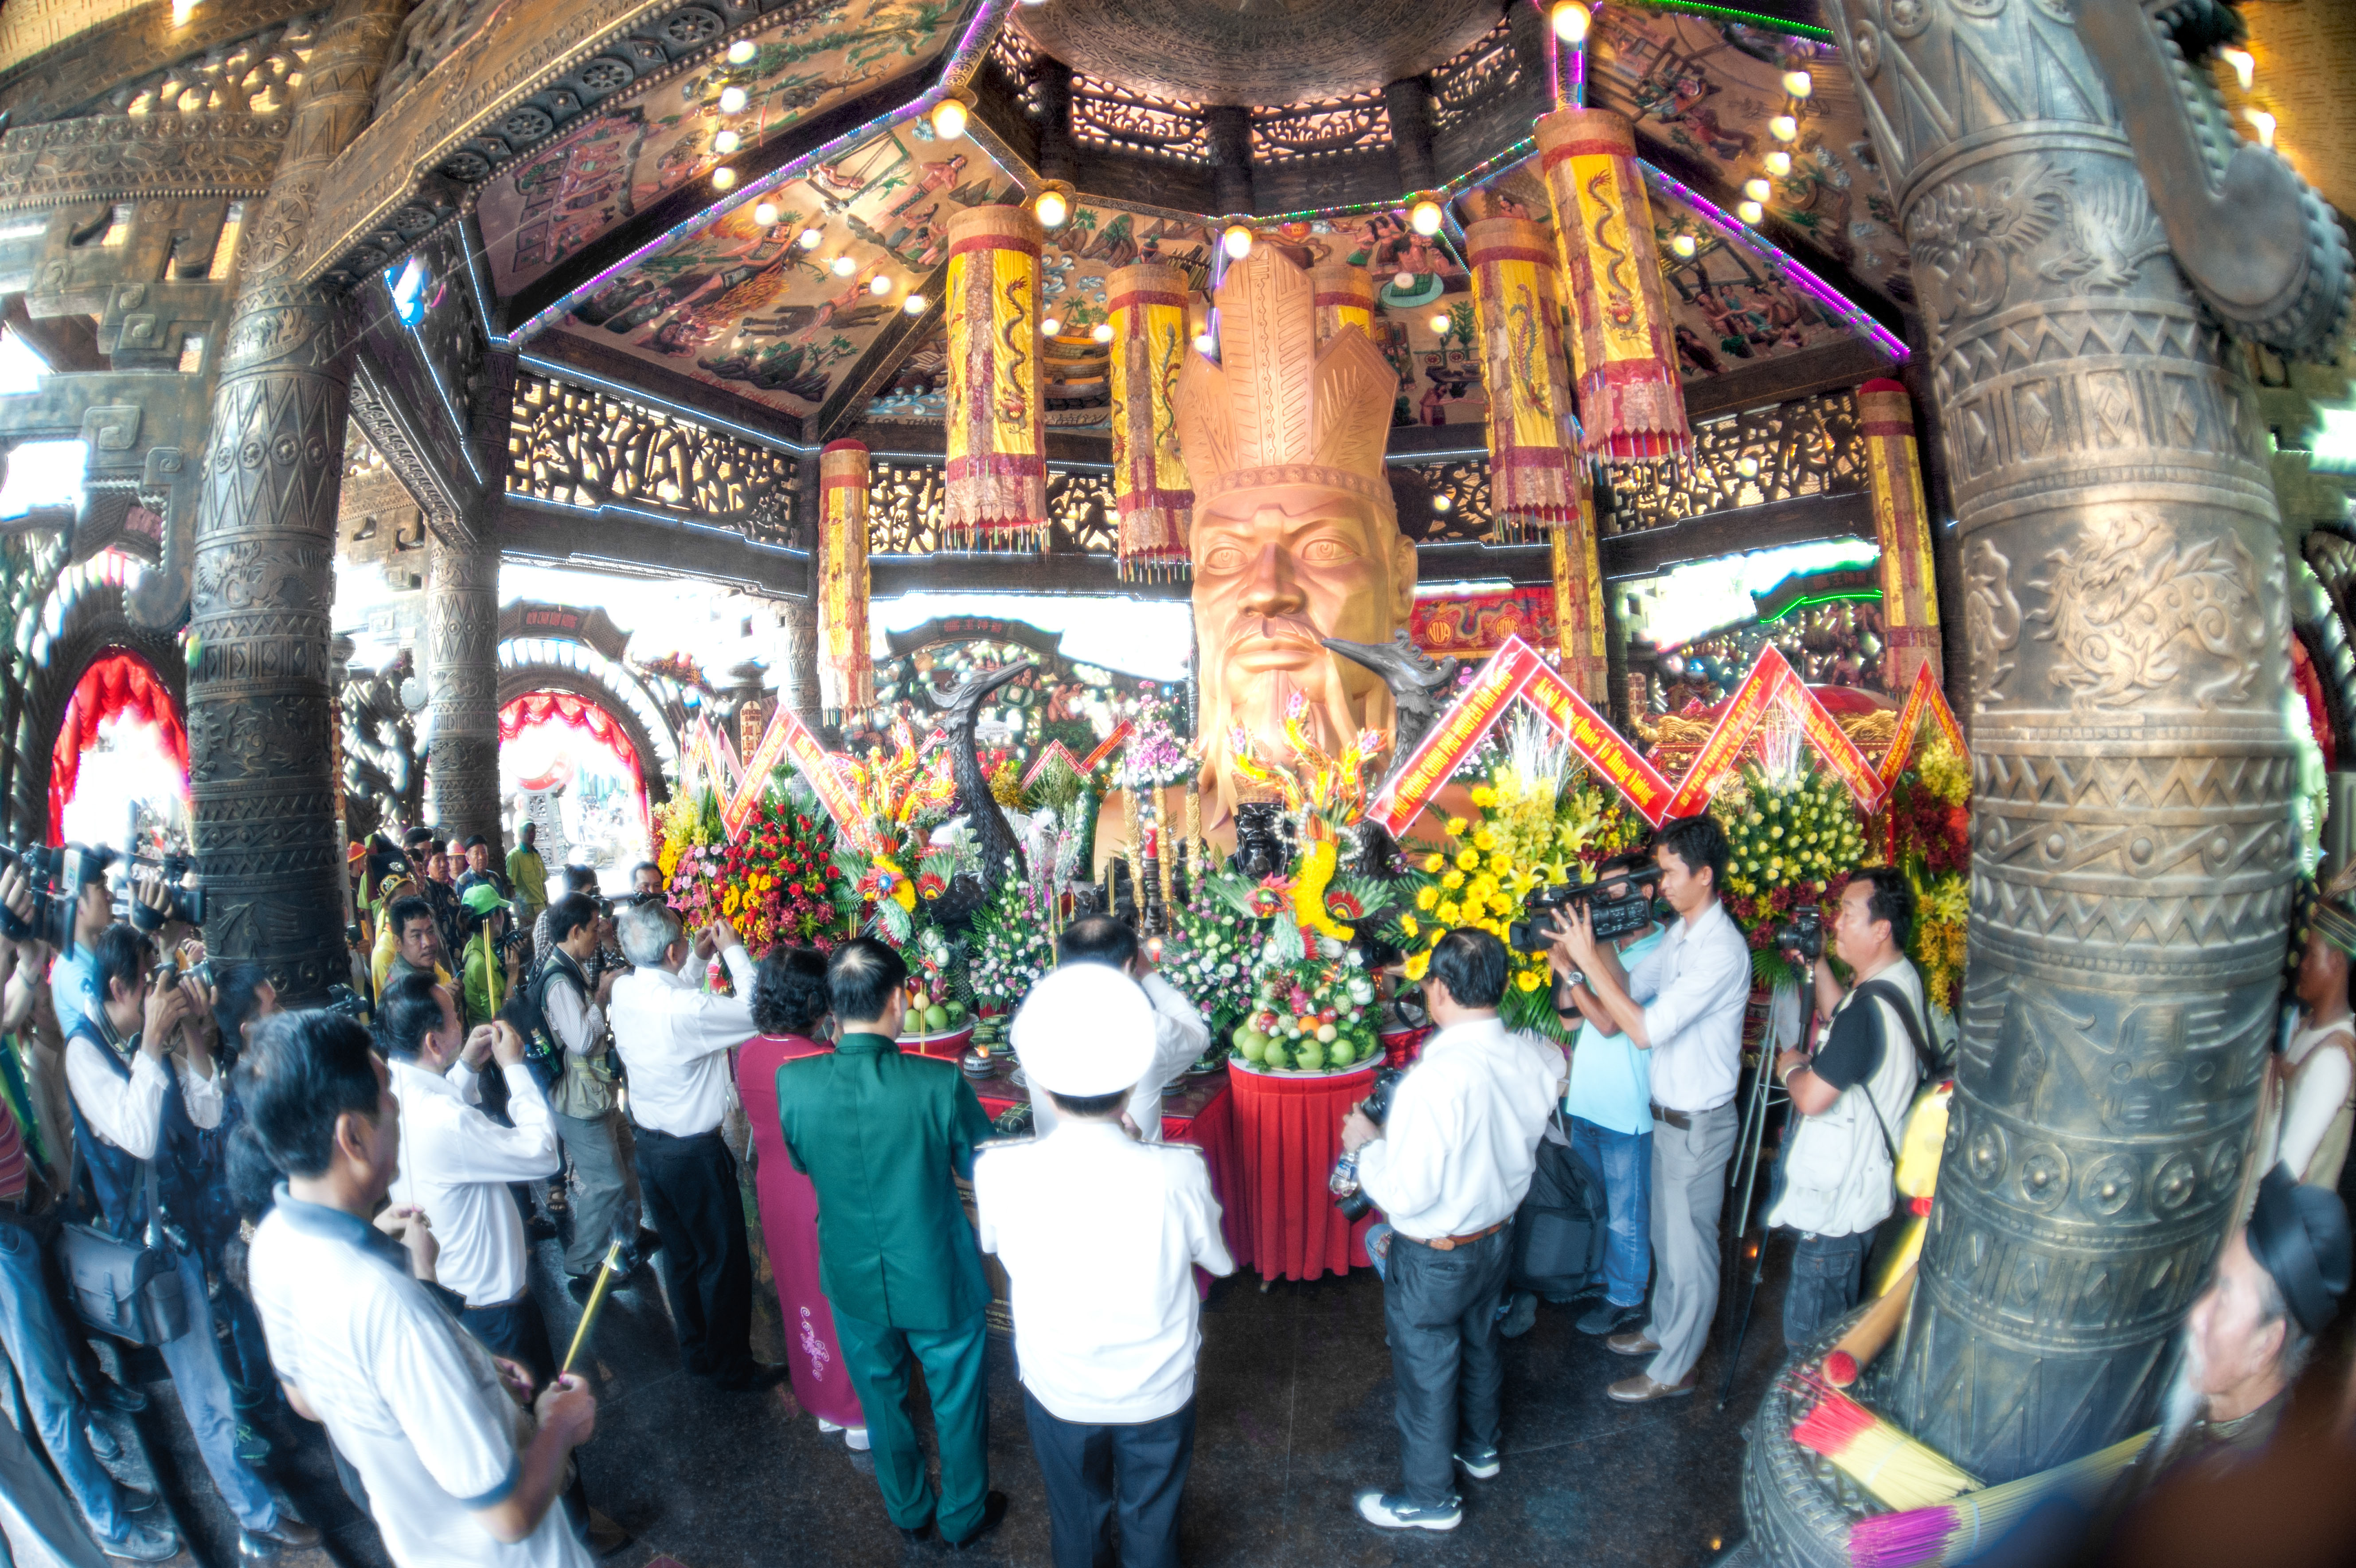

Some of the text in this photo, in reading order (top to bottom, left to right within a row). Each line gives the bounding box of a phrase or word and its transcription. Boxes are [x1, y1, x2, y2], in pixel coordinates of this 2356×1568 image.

[1429, 621, 1452, 643] VUA
[1736, 676, 1762, 713] TP.HCM
[1606, 749, 1633, 784] Hùng
